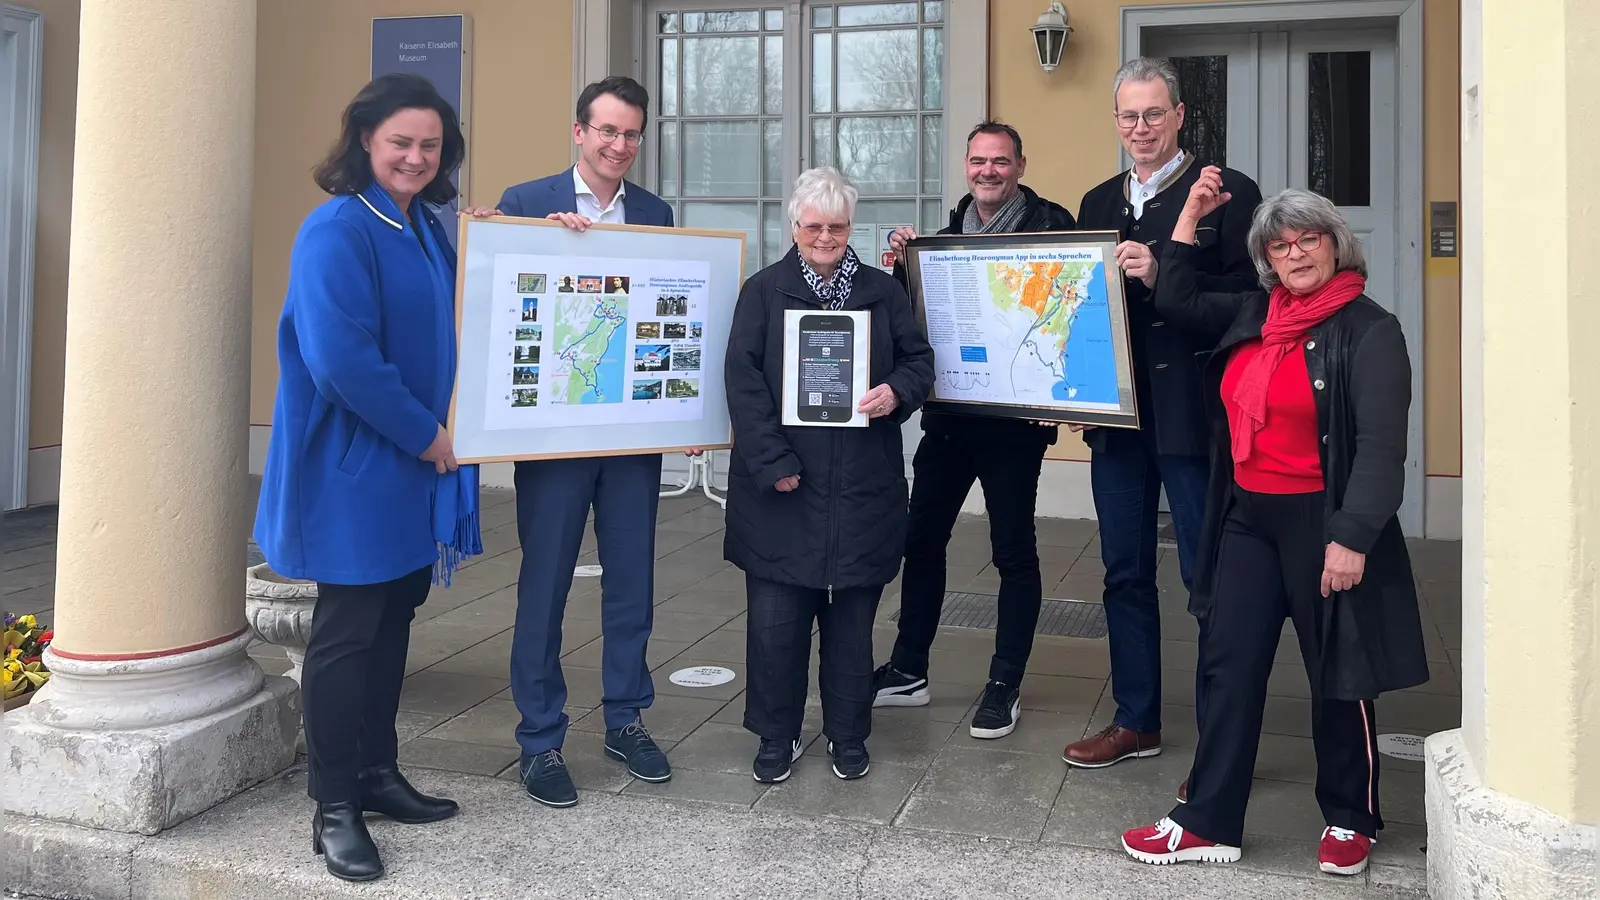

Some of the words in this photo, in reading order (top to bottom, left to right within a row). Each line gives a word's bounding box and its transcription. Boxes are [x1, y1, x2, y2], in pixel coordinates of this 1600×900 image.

[399, 42, 426, 50] Kaiserin
[427, 41, 458, 49] Elisabeth
[399, 54, 427, 62] Museum
[929, 255, 971, 263] Elisabethweg
[971, 254, 1014, 263] Hearonymus
[1015, 254, 1028, 262] App
[1038, 252, 1057, 260] sechs
[1058, 252, 1092, 260] Sprachen
